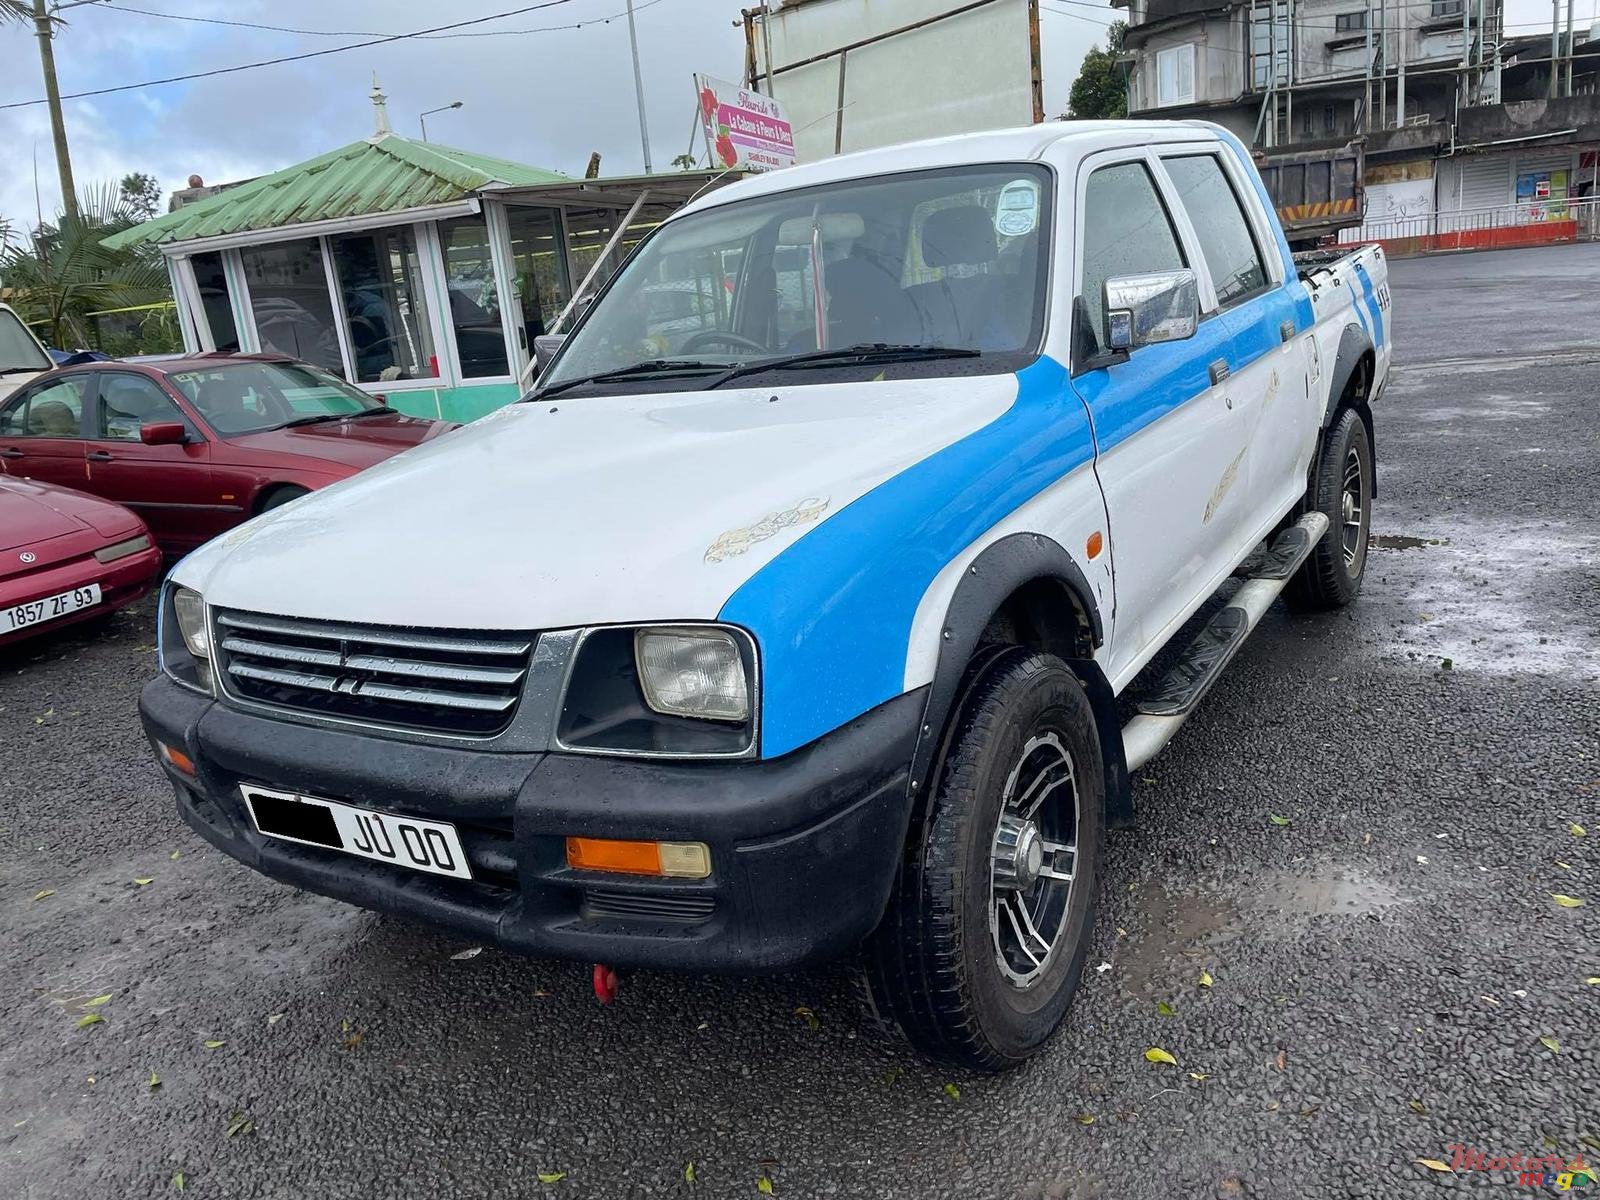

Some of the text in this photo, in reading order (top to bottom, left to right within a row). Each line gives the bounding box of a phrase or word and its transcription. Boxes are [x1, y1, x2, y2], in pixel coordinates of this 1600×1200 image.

[728, 112, 737, 129] La
[736, 114, 757, 135] Cabane
[8, 588, 93, 628] 1857 ZF 93
[353, 814, 397, 859] JU
